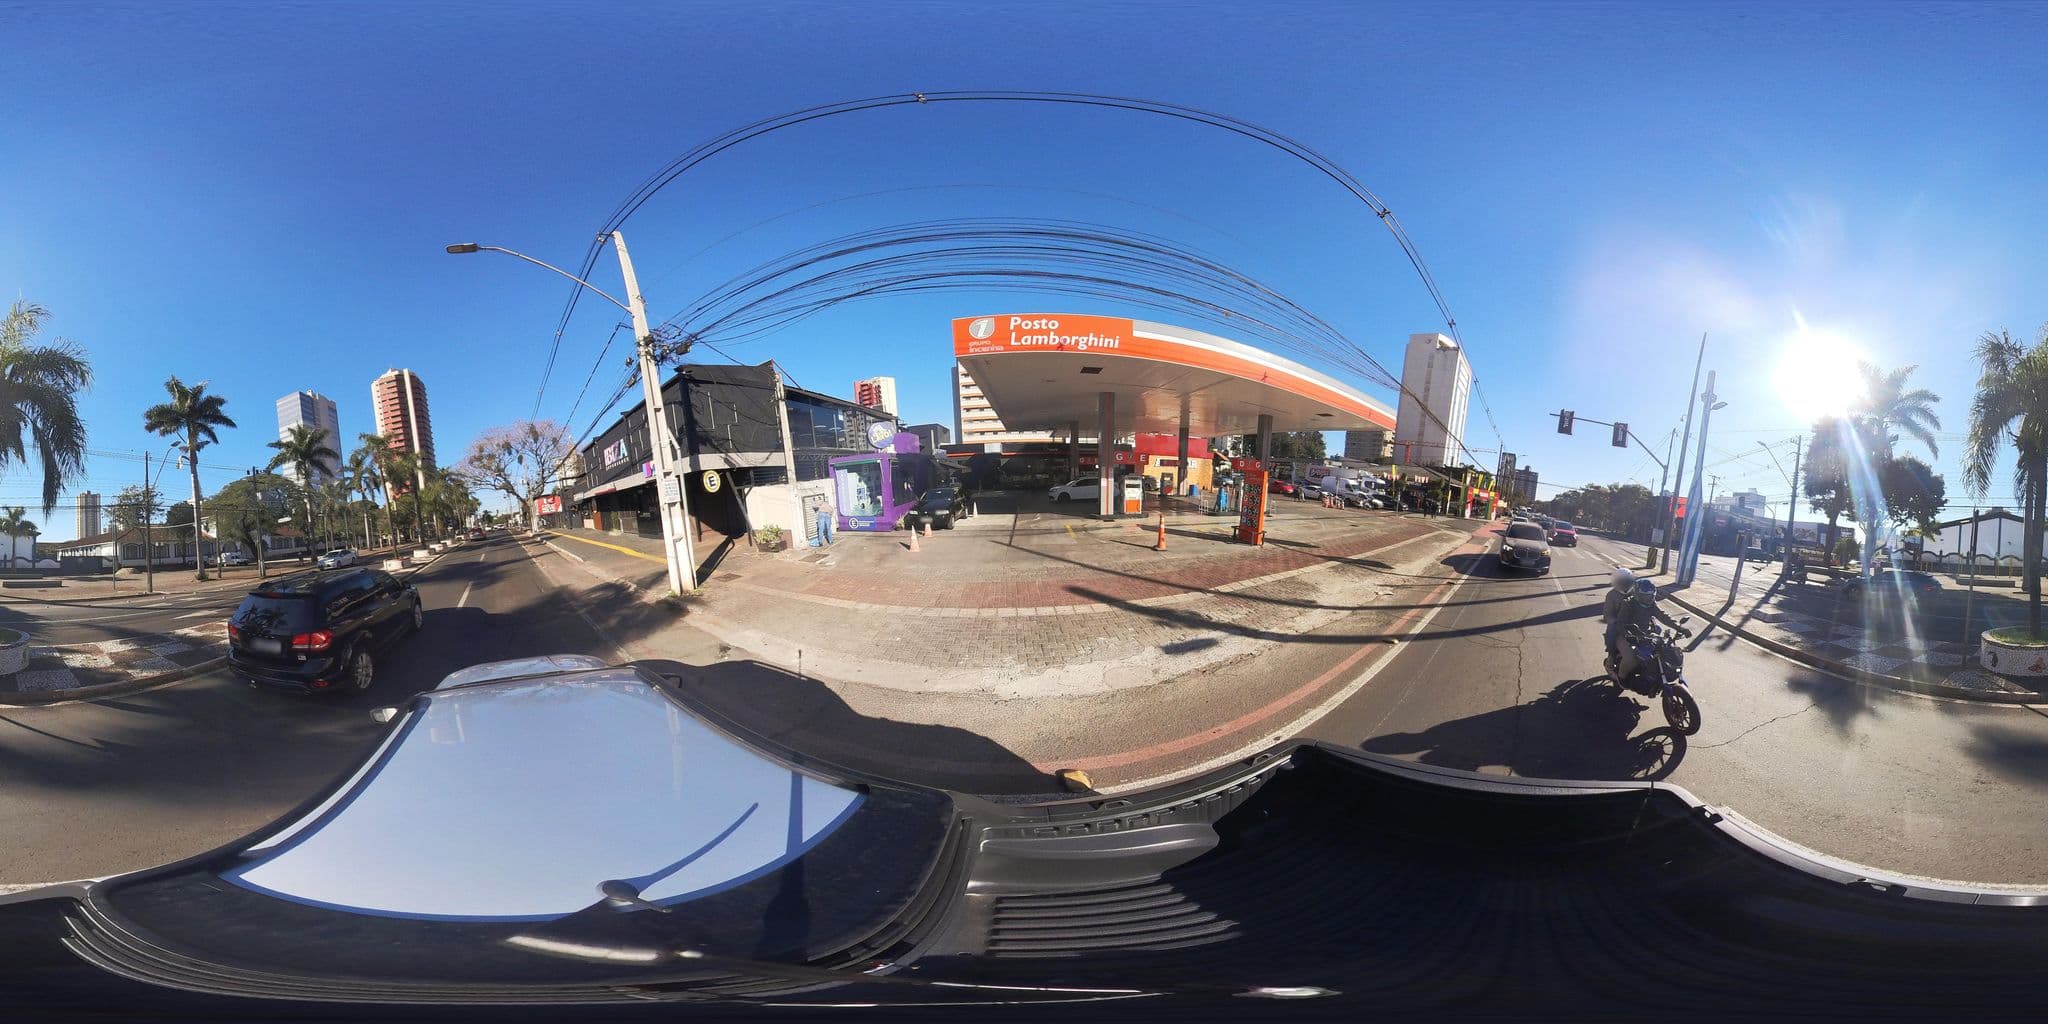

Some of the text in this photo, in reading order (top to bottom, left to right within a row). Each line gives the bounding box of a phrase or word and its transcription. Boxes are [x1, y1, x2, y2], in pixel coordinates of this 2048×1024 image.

[1010, 316, 1059, 330] Posto
[1010, 331, 1120, 350] Lamborghini
[708, 475, 717, 488] E
